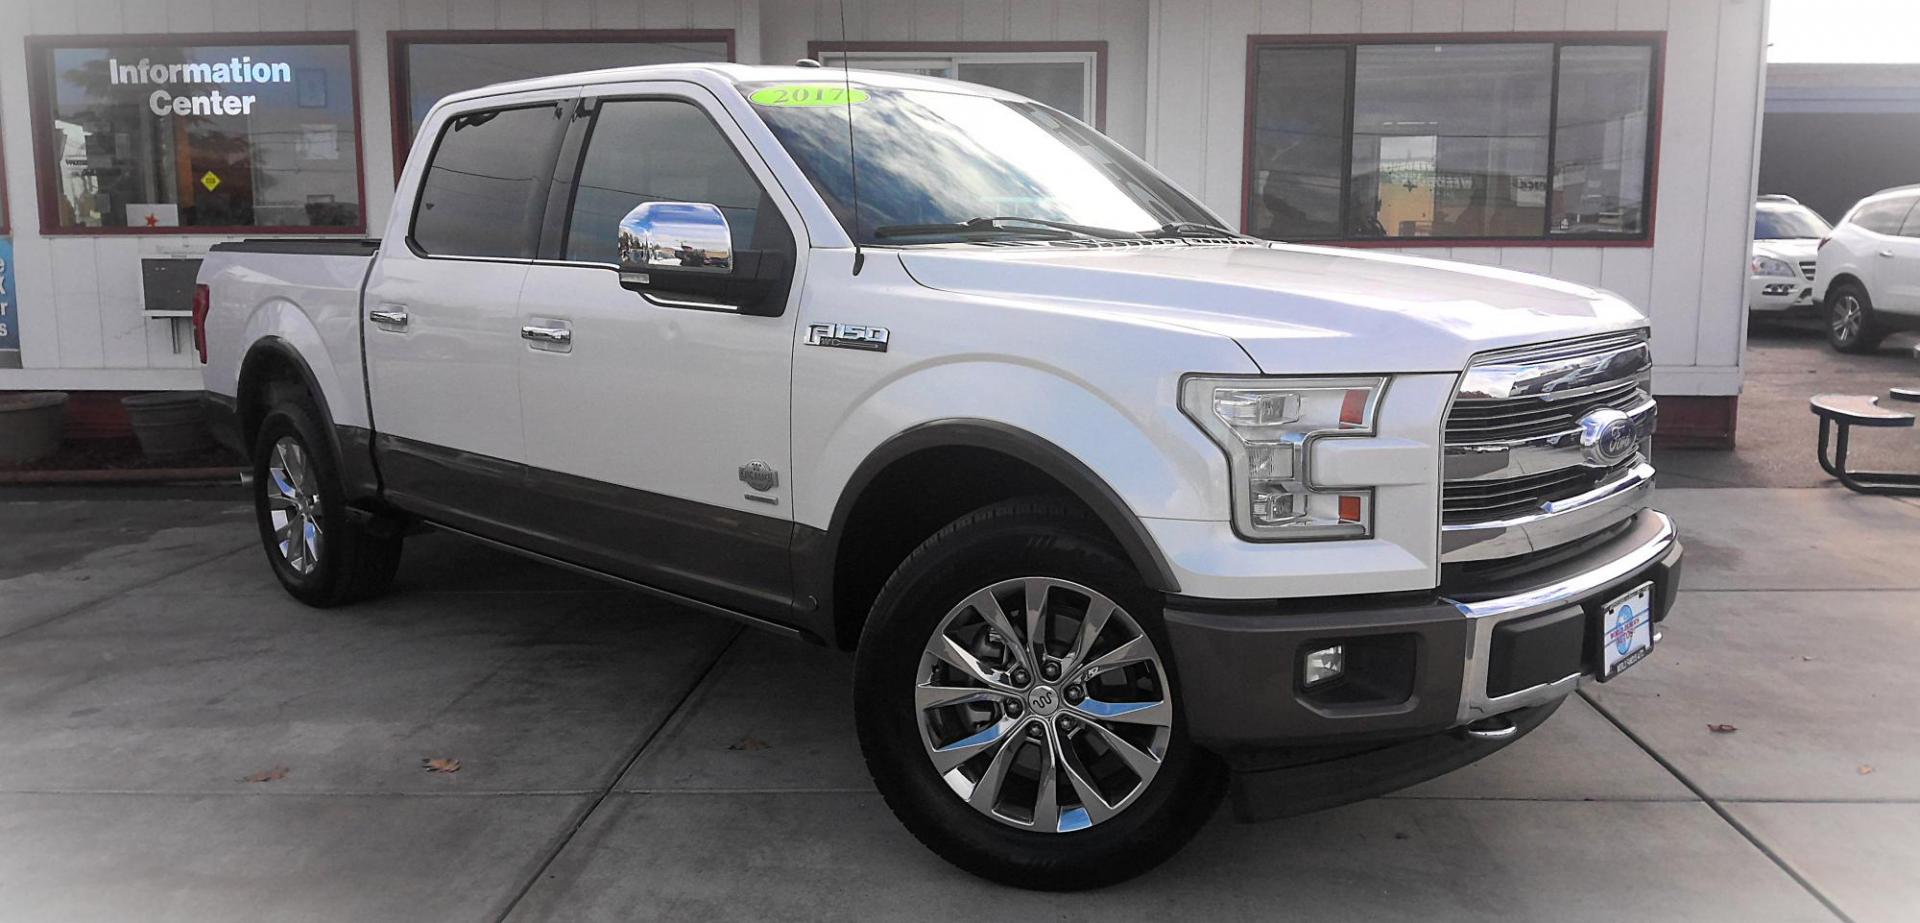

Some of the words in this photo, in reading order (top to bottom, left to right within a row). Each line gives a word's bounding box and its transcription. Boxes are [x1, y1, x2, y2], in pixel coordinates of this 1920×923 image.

[109, 56, 291, 84] Information
[150, 89, 256, 116] Center
[774, 88, 844, 103] 2017
[1610, 424, 1631, 452] Ford
